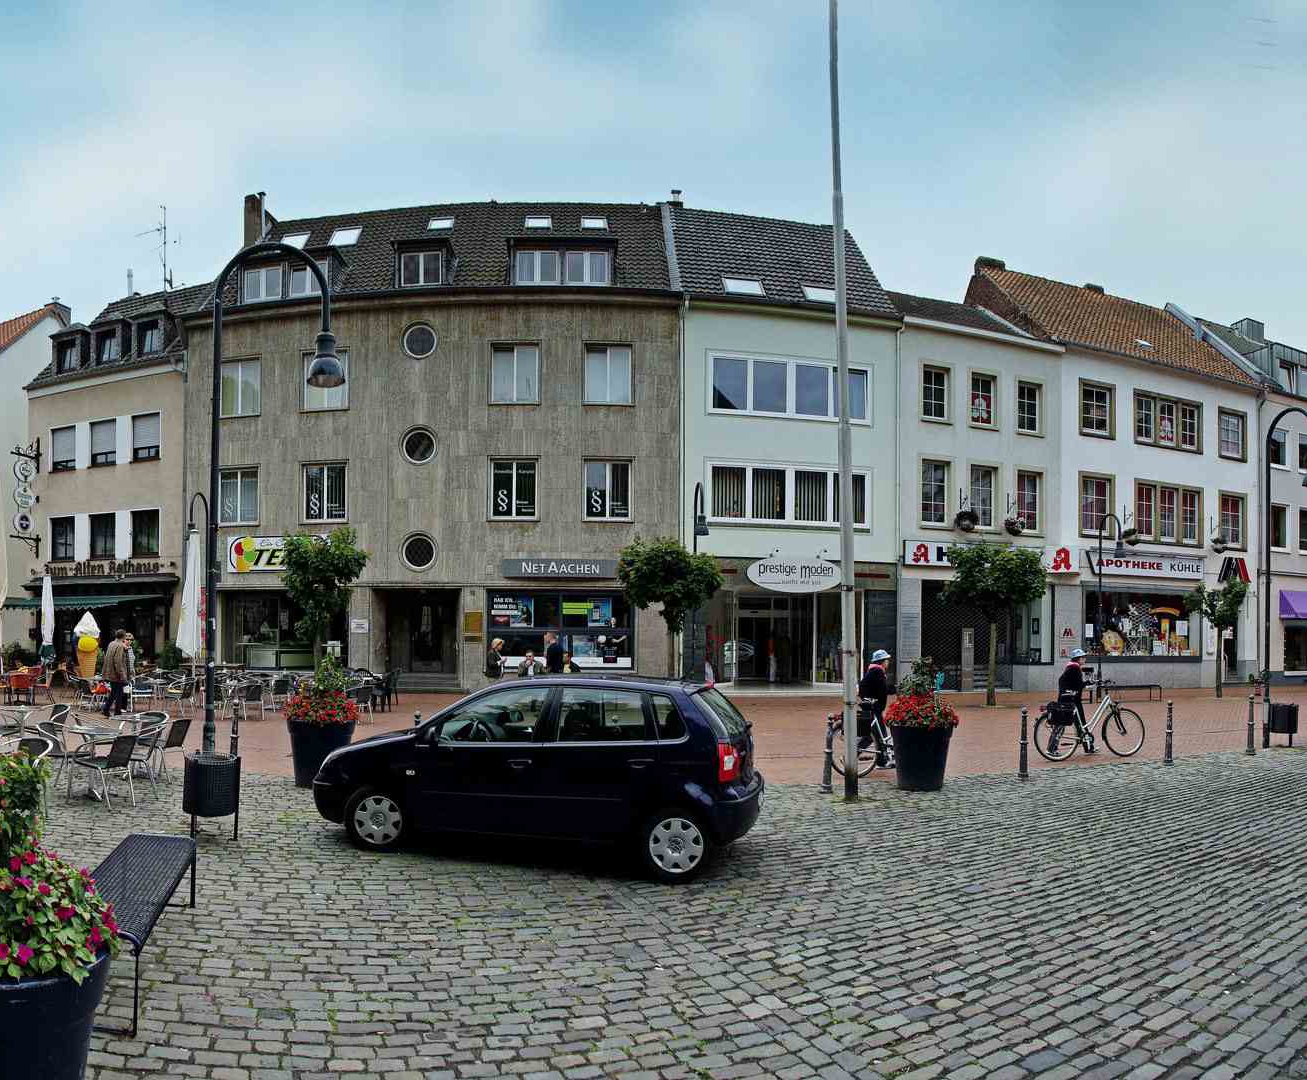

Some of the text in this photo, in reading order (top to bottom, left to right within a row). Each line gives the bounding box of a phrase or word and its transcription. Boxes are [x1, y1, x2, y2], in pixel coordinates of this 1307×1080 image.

[758, 563, 833, 578] prestige moden
[1096, 558, 1201, 573] APOTHEKE KÜHLE
